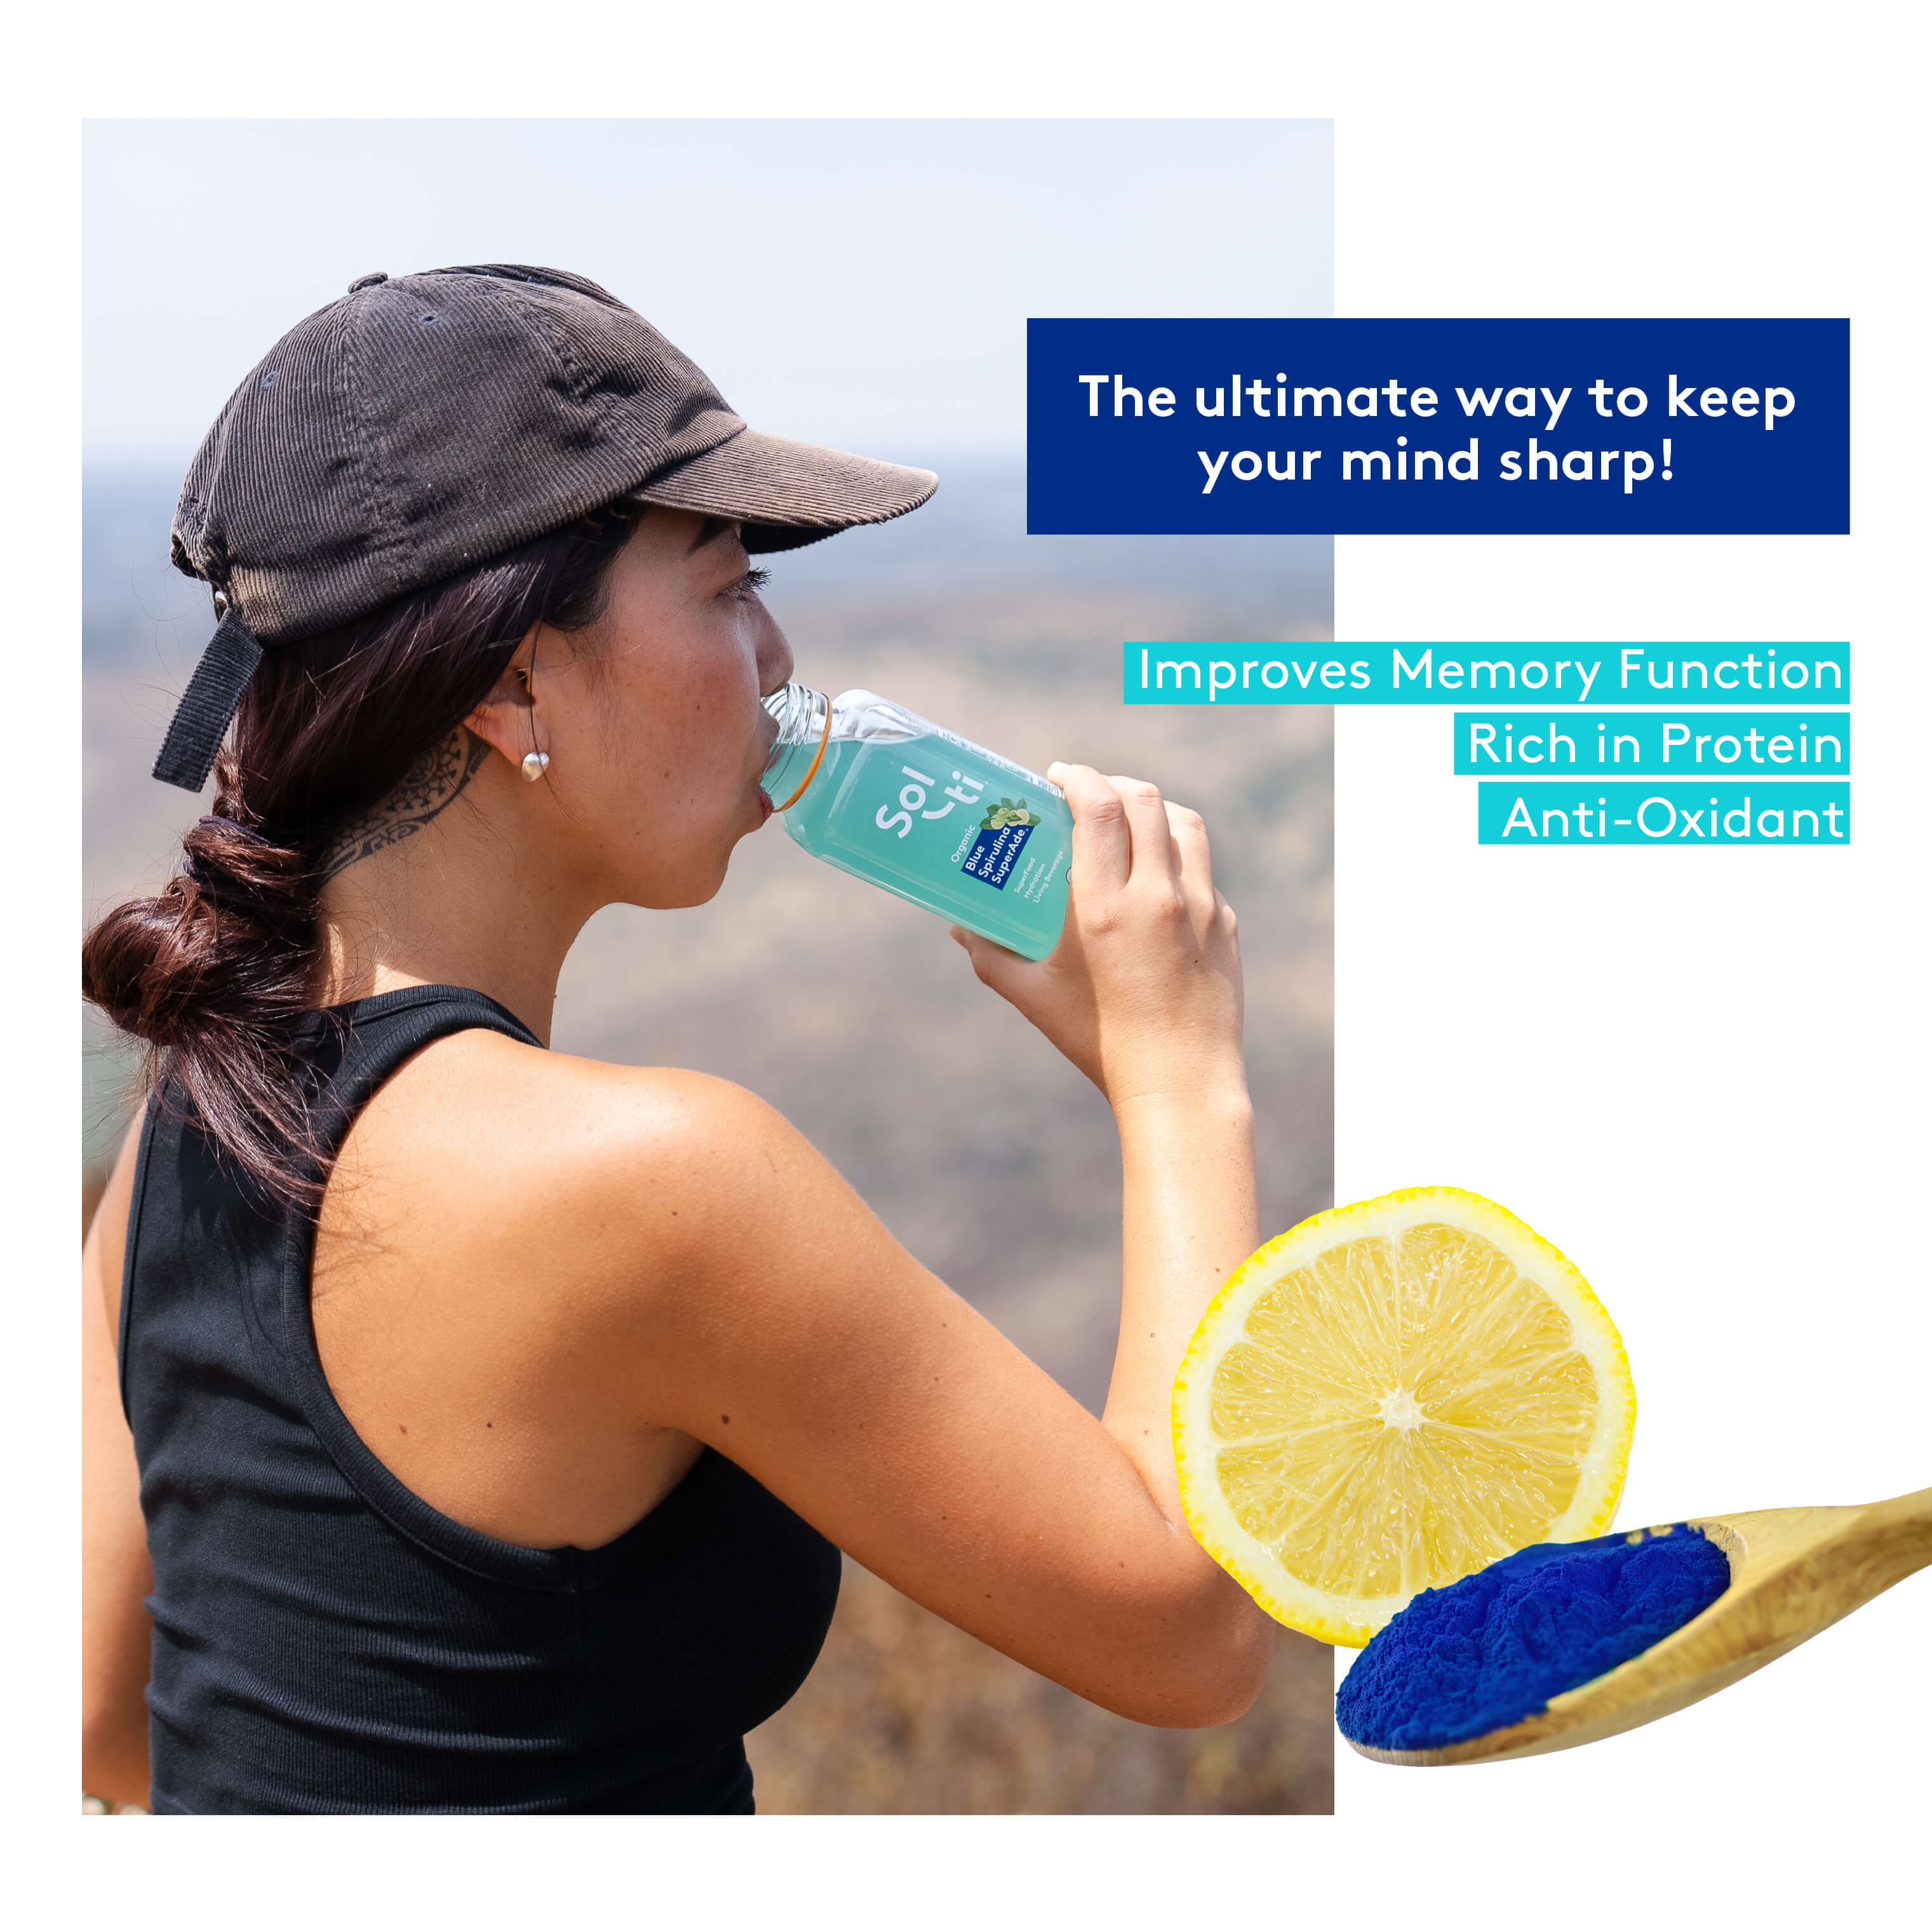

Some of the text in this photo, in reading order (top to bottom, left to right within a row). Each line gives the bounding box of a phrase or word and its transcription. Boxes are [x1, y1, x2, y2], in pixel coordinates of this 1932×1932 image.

[875, 765, 936, 839] Sol
[951, 825, 976, 862] Organic
[965, 845, 985, 871] Blue
[978, 826, 1010, 878] Spirulina
[1024, 863, 1046, 899] Hydration
[1032, 850, 1063, 903] Living Beverage
